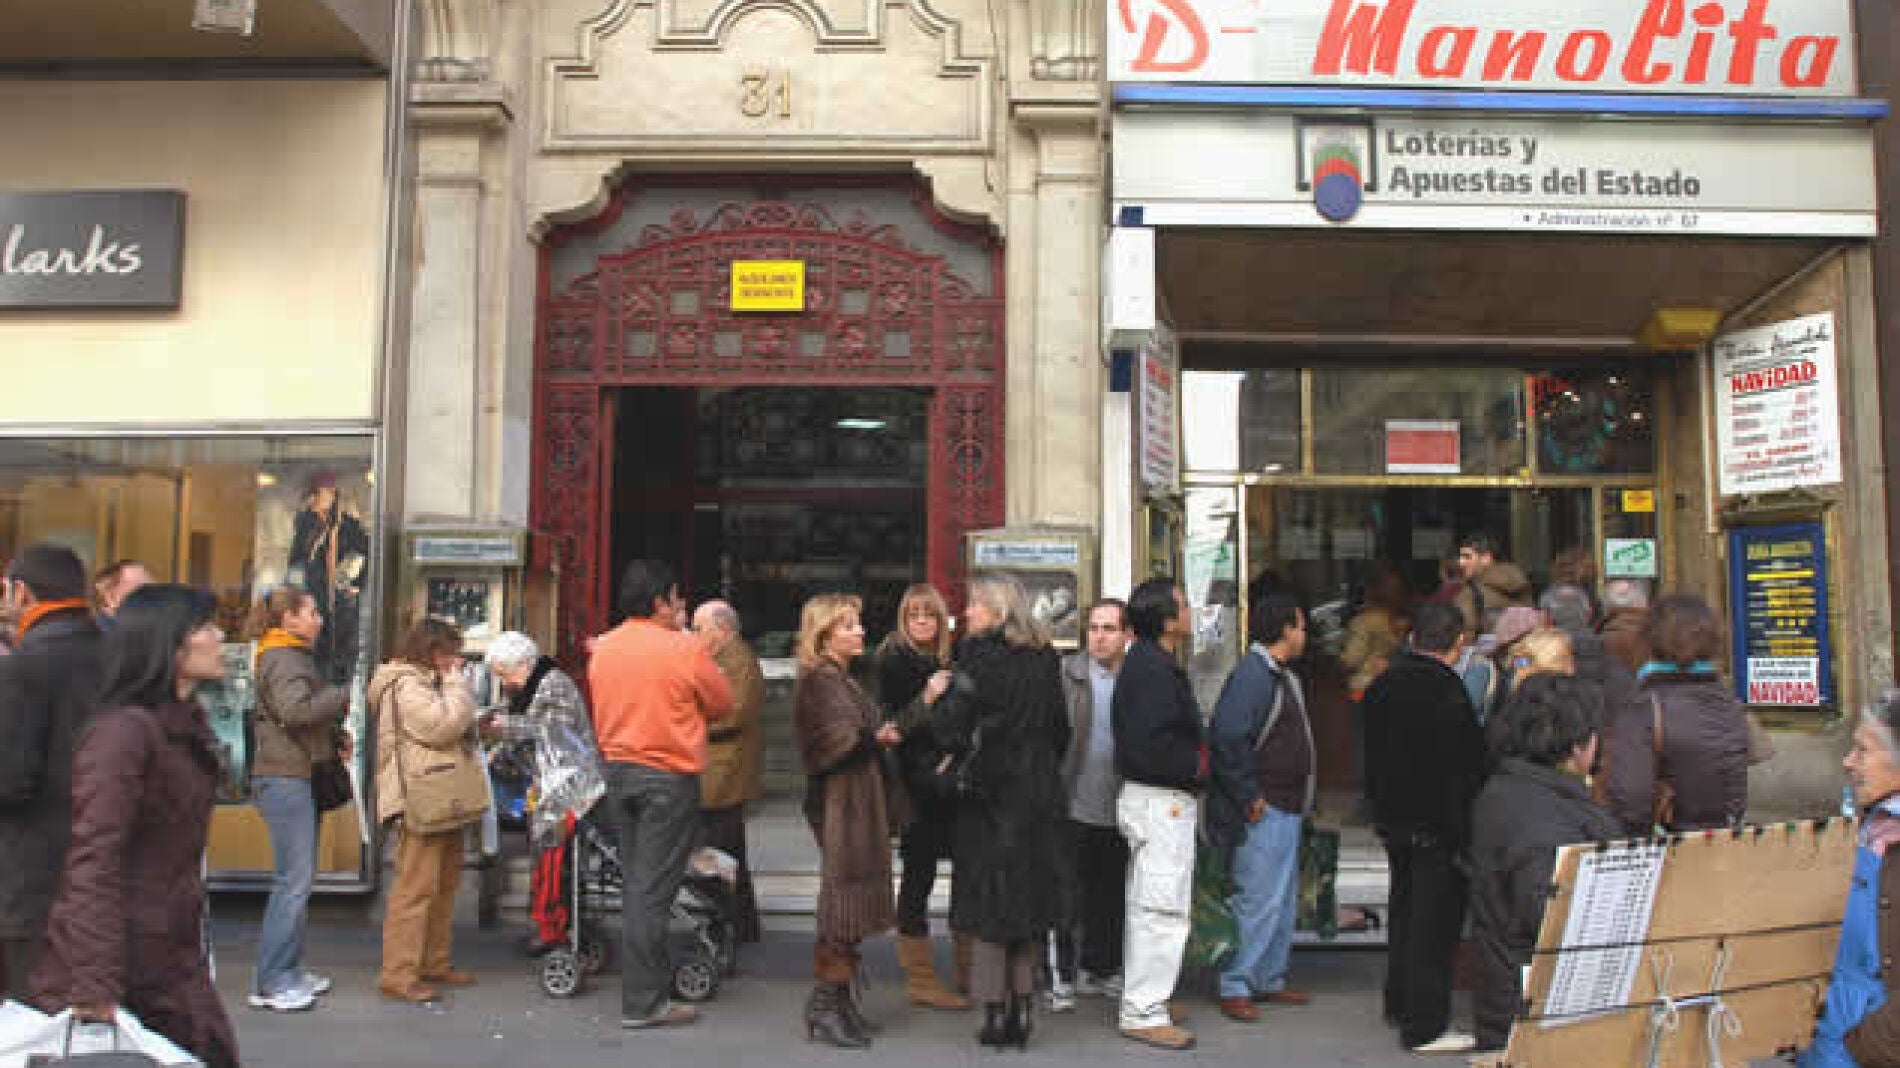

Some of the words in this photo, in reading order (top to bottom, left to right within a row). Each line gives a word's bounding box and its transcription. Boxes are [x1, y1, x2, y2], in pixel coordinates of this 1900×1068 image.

[741, 65, 791, 118] 31
[1386, 128, 1512, 156] Loterías
[1520, 137, 1537, 165] y
[1388, 166, 1533, 198] Apuestas
[1541, 167, 1587, 195] del
[1597, 168, 1701, 196] Estado
